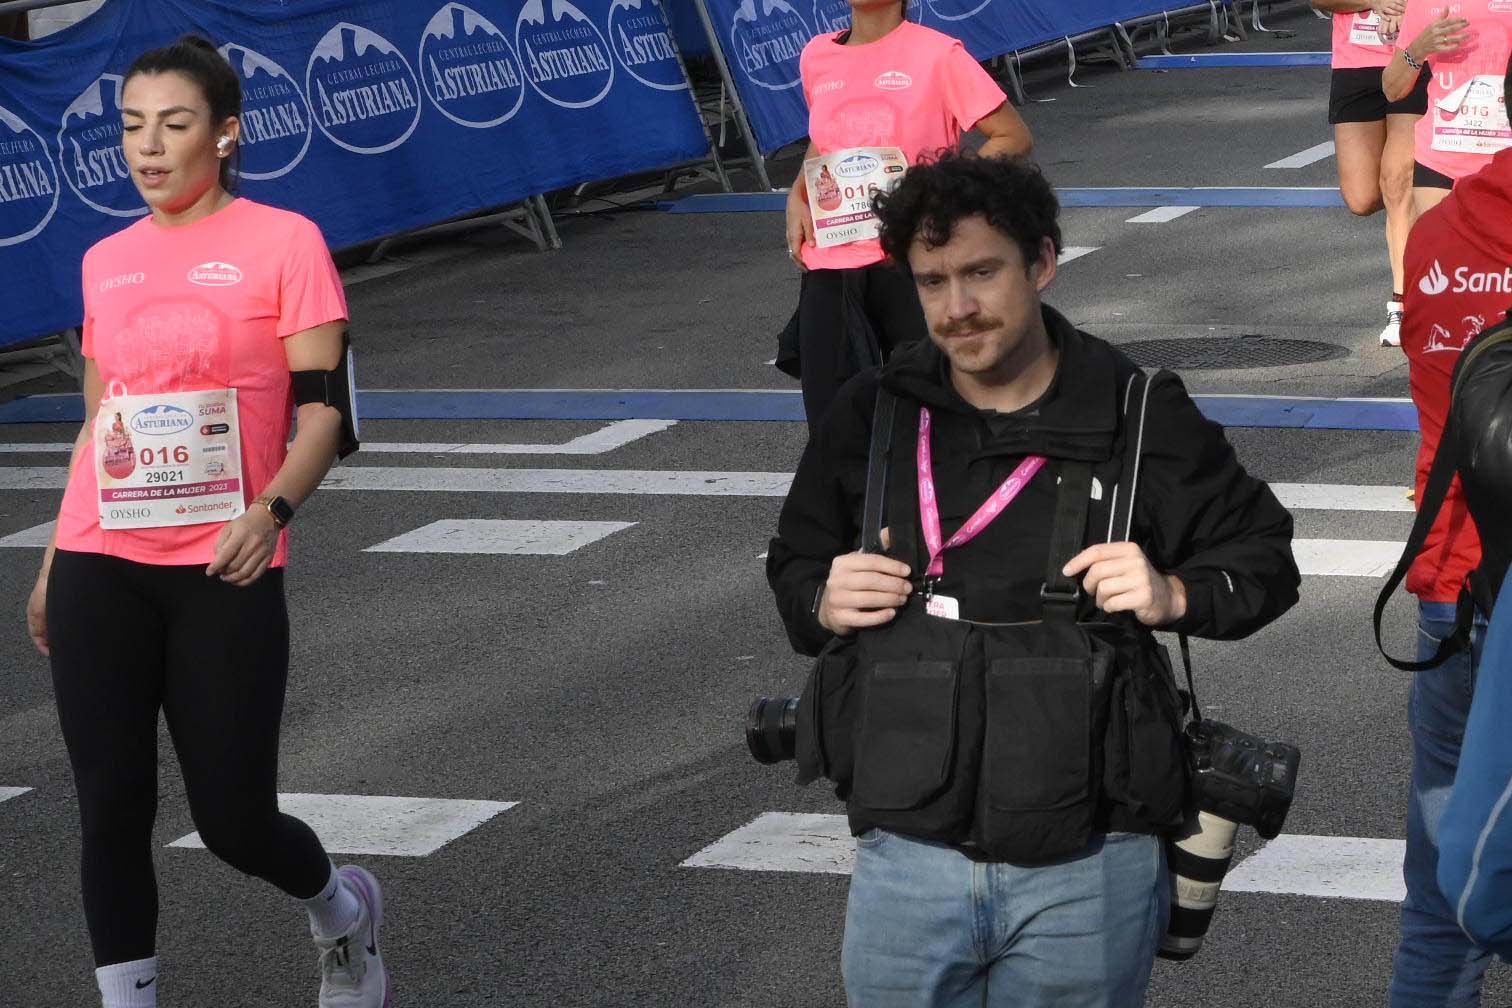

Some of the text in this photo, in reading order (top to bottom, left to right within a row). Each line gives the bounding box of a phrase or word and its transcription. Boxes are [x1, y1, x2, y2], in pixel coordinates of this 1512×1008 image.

[525, 38, 610, 84] ASTURIANA
[327, 60, 401, 86] CENTRAL LECHERA
[428, 53, 521, 102] ASTURIANA
[315, 75, 418, 128] ASTURIANA
[1460, 104, 1489, 117] 016
[239, 100, 307, 146] URIANA
[70, 136, 130, 190] ASTU
[826, 217, 854, 226] CARRERA
[826, 227, 858, 240] OYSHO
[199, 406, 226, 417] SUMA
[135, 416, 189, 429] ASTURIANA
[139, 445, 190, 466] 016
[145, 471, 184, 483] 29021
[112, 483, 228, 499] CARRERA DE LA MUJER 2023
[110, 507, 151, 520] OYSHO
[187, 501, 233, 514] Santander
